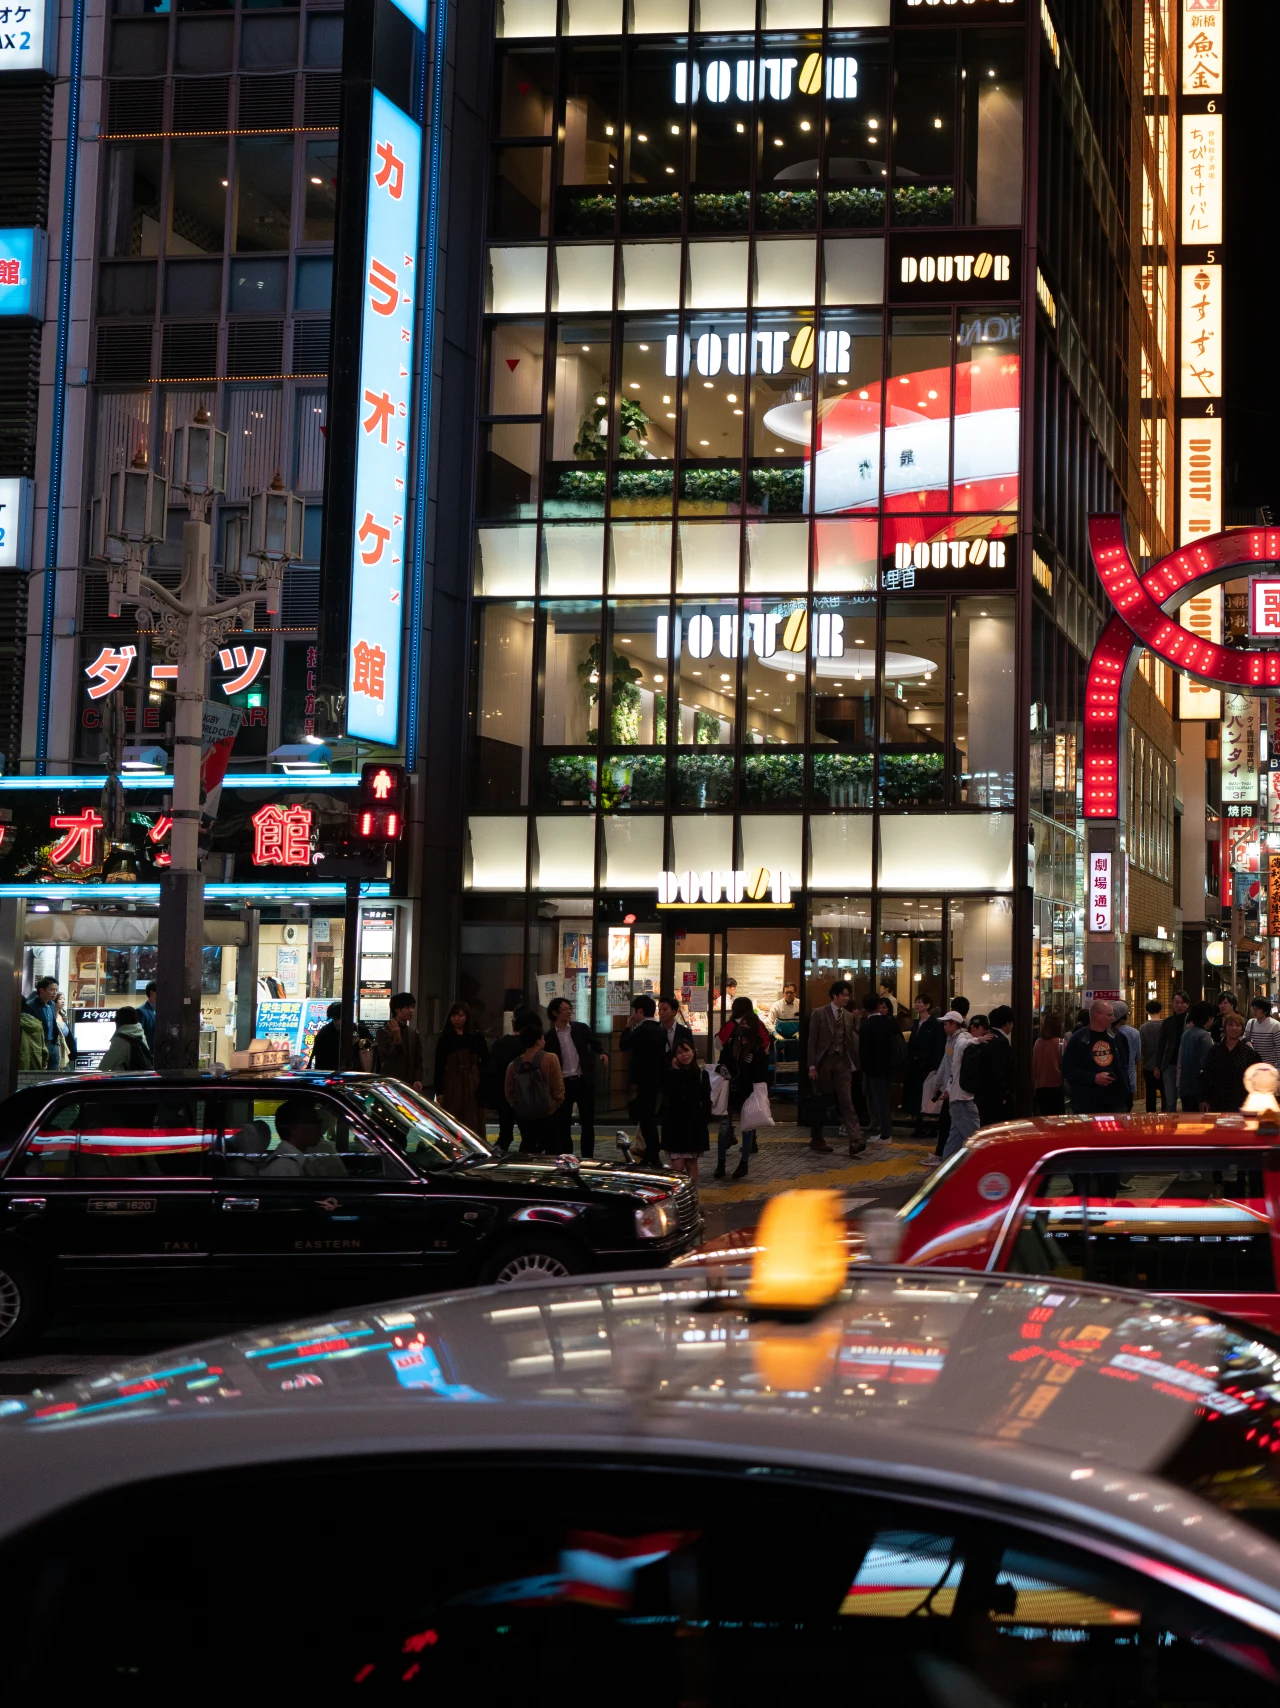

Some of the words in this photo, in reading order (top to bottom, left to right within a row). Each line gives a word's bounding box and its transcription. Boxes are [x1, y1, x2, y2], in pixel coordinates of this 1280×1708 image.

[1190, 14, 1216, 28] 新橋
[1187, 31, 1220, 90] 魚金
[1207, 100, 1216, 113] 6
[1188, 128, 1209, 231] ちびすけバル
[901, 253, 1011, 283] DOUTOR
[1206, 250, 1216, 264] 5
[1190, 293, 1214, 394] すずや
[352, 138, 406, 704] カラオケ館
[1205, 403, 1215, 417] 4
[895, 538, 1006, 570] DOUTOR
[1226, 715, 1244, 778] バンタイ
[1232, 791, 1247, 799] 3F
[1227, 805, 1253, 818] 焼肉
[1094, 857, 1108, 926] 劇場通り
[295, 1240, 361, 1250] EASTERN
